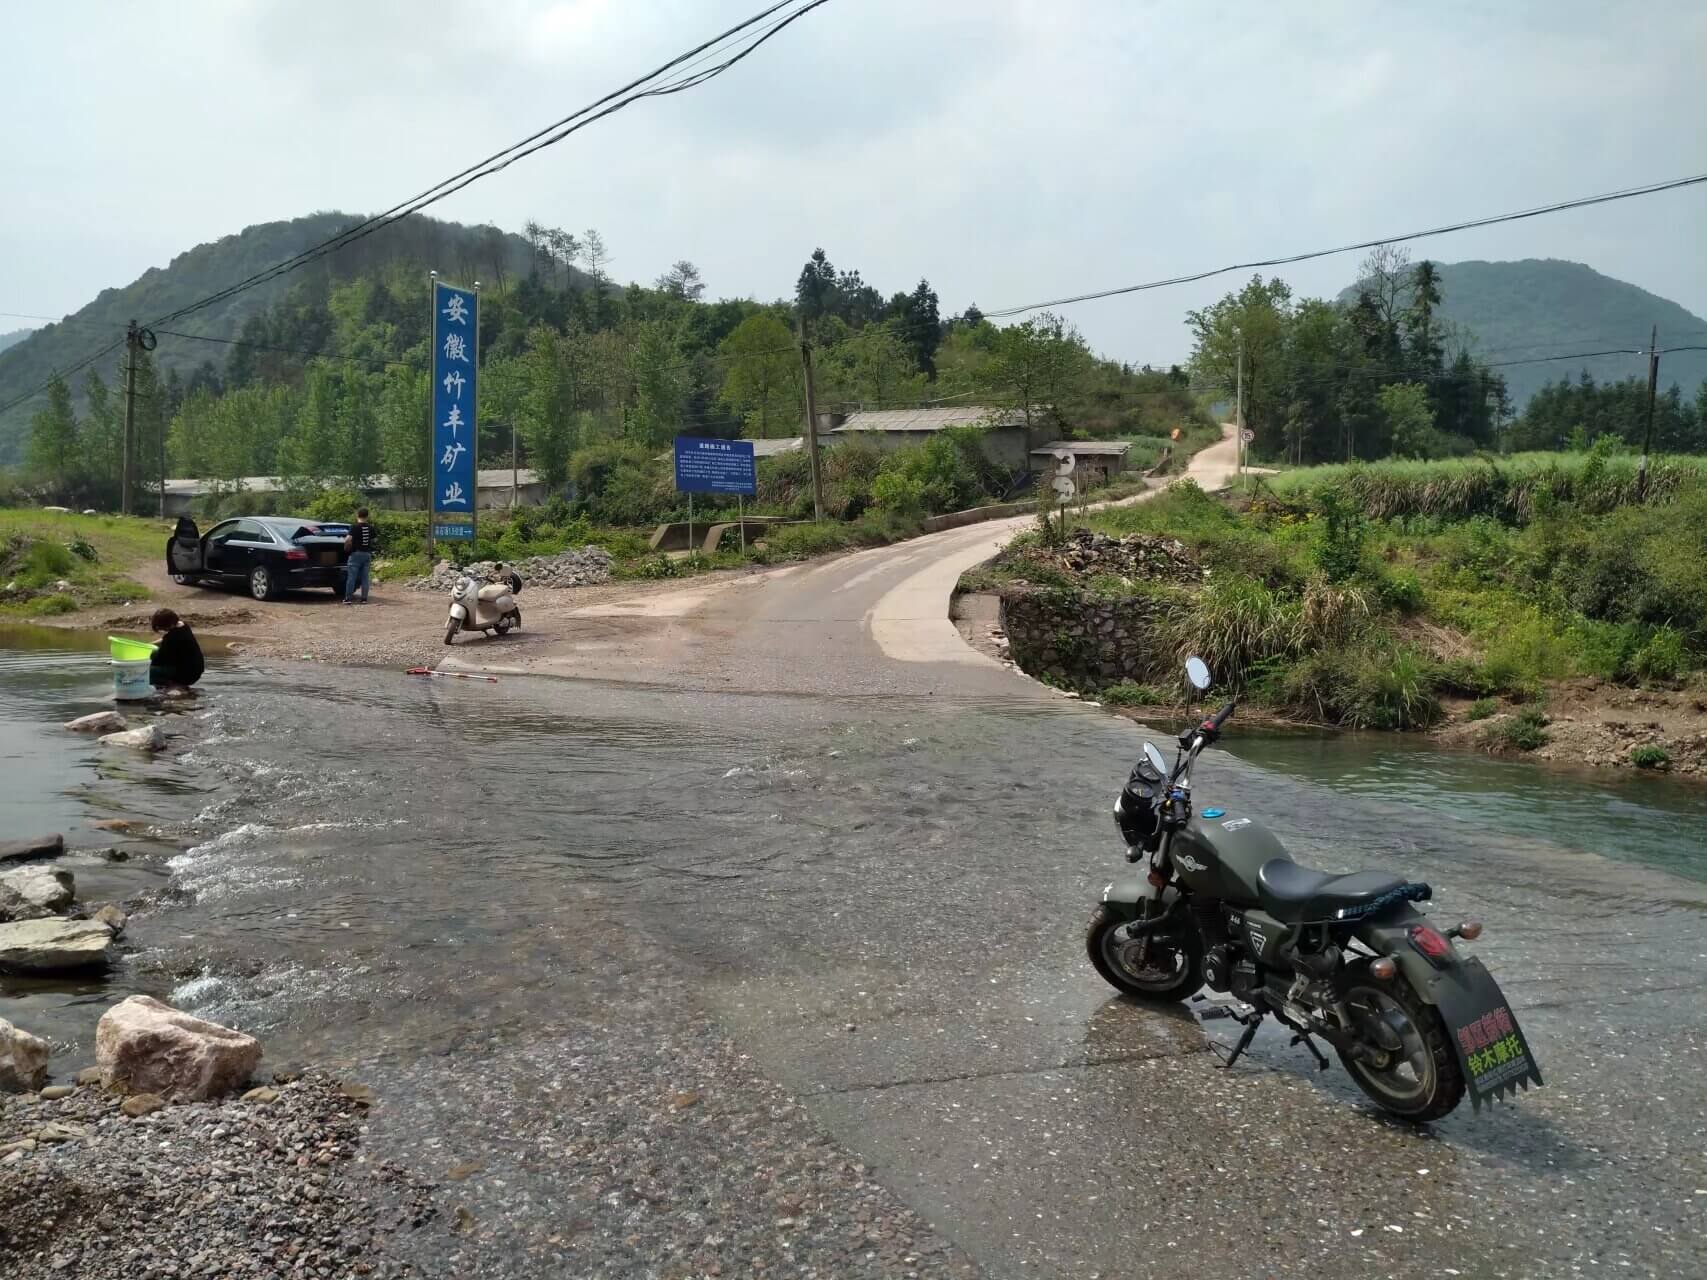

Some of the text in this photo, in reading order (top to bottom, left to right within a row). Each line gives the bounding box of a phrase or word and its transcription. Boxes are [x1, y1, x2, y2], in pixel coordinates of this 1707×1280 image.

[441, 293, 470, 505] 安徽竹丰矿业
[1468, 1034, 1523, 1077] 铃木摩托
